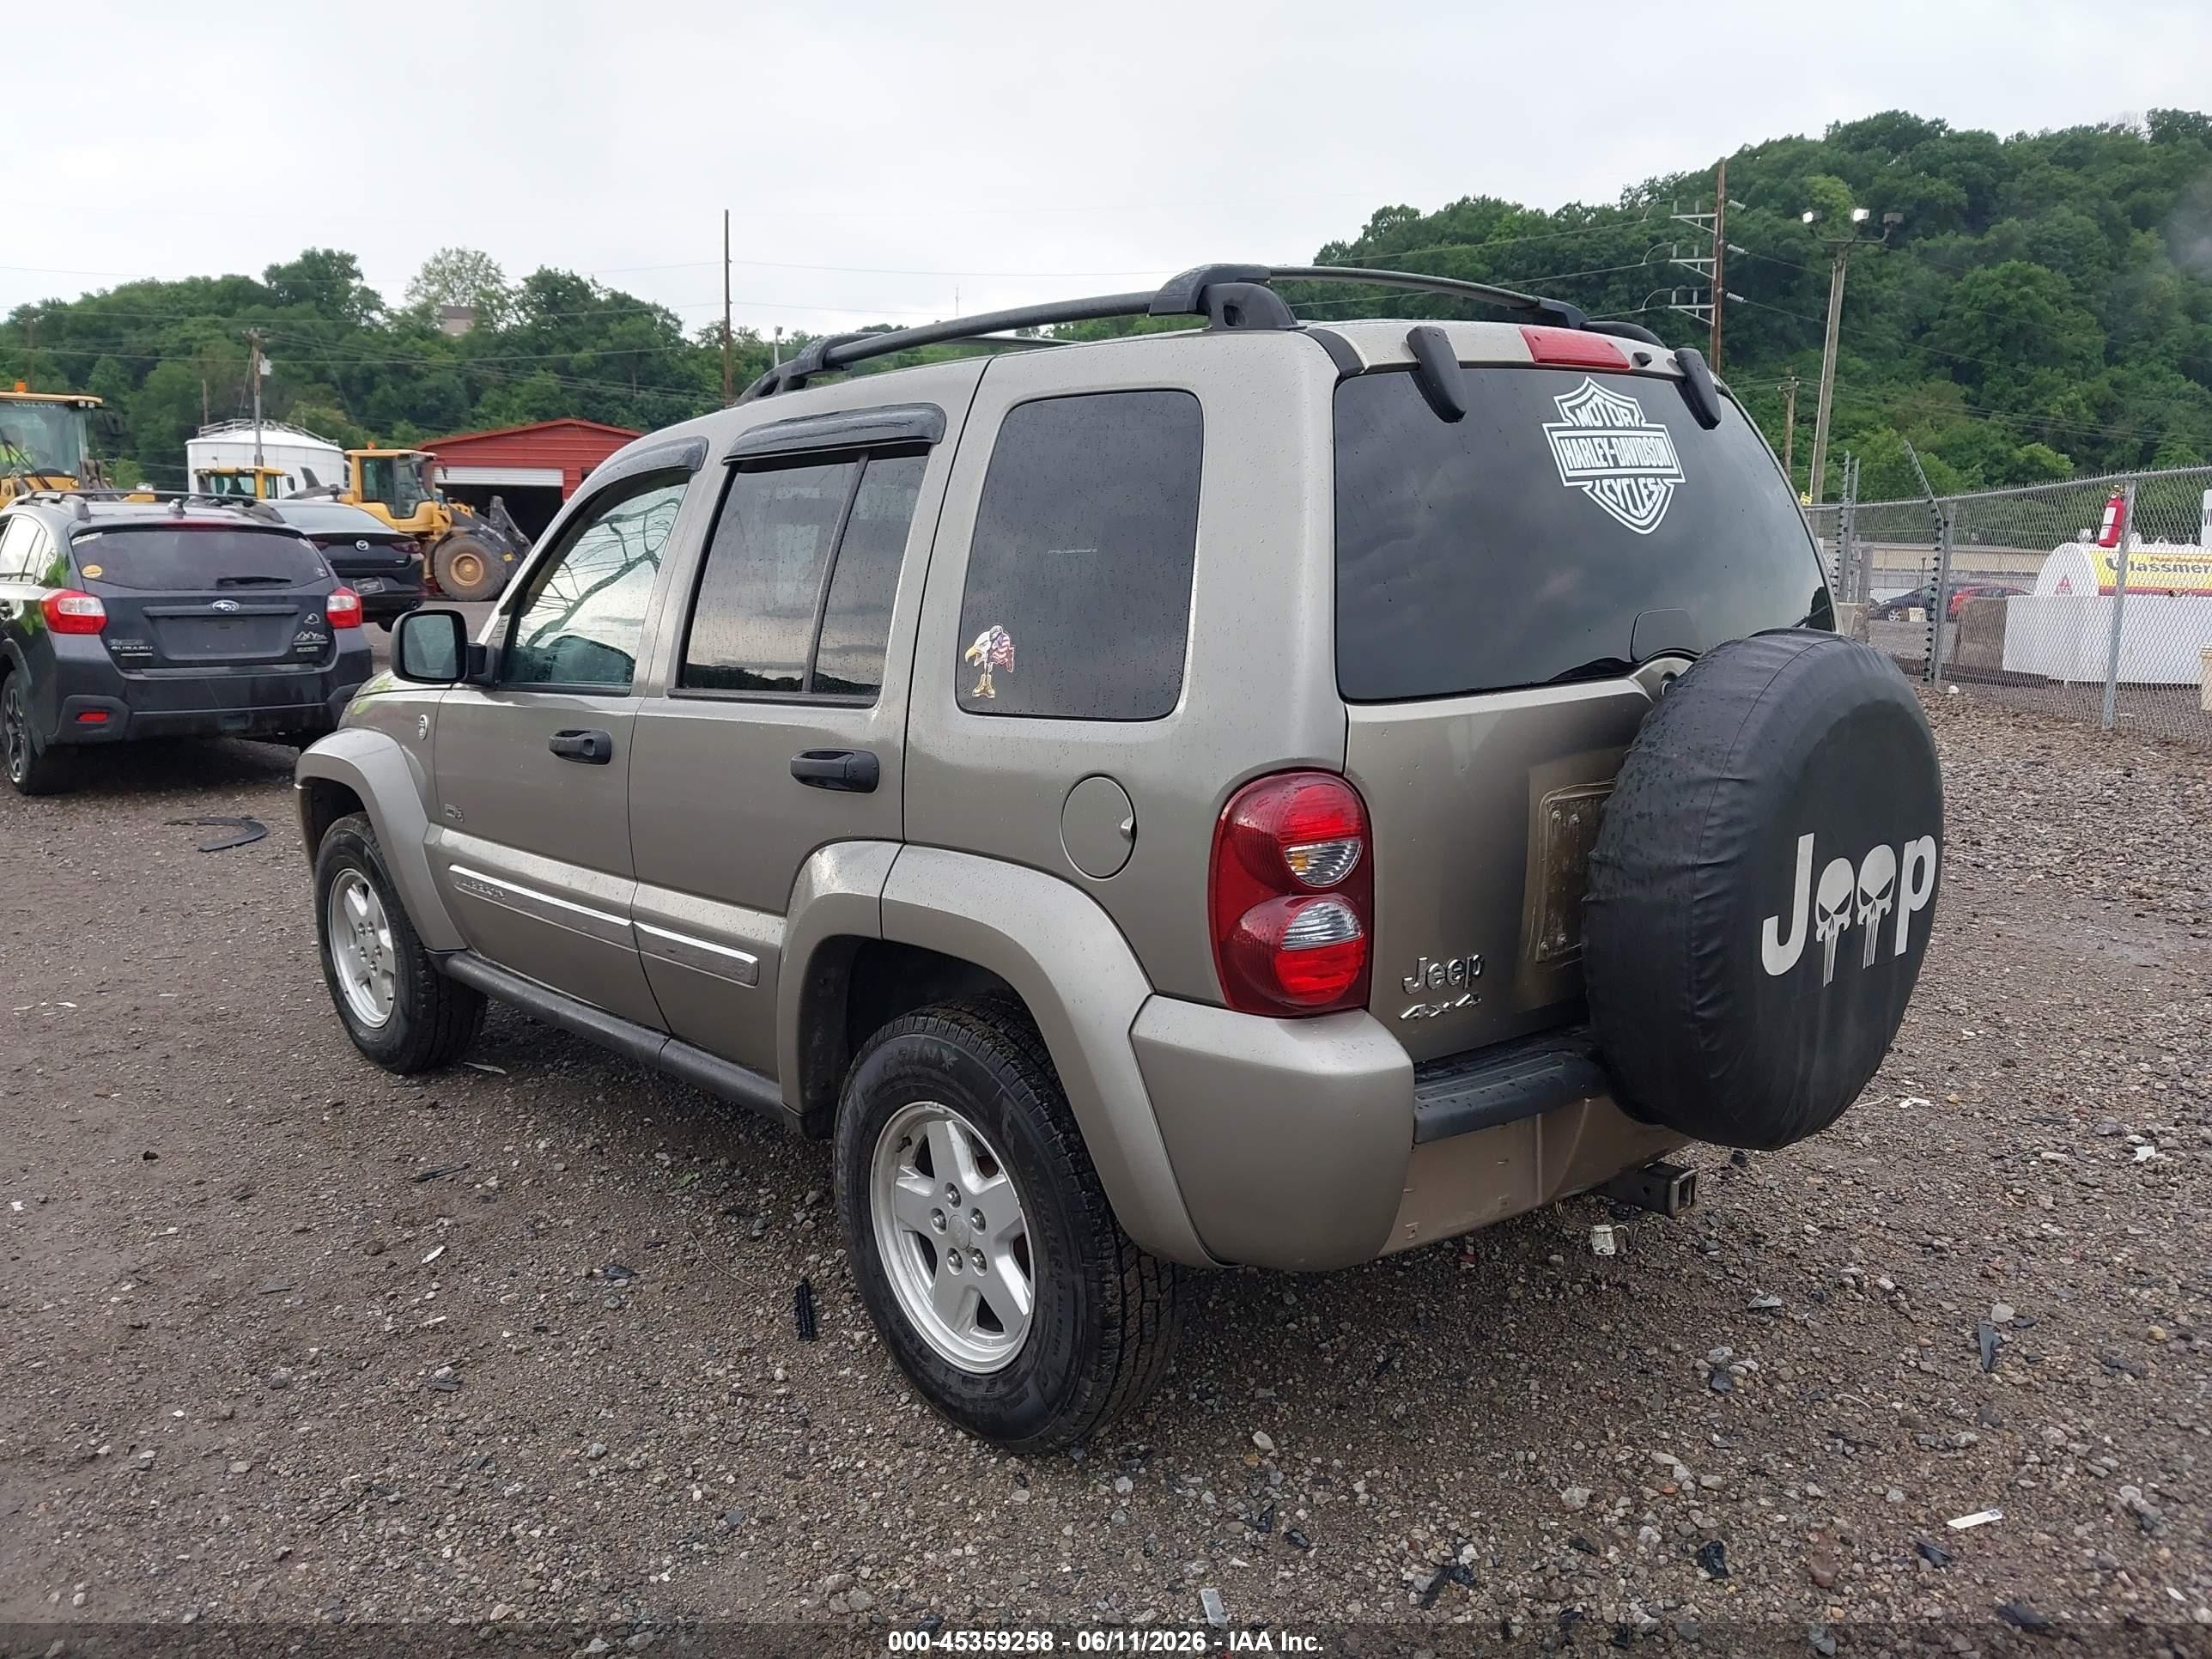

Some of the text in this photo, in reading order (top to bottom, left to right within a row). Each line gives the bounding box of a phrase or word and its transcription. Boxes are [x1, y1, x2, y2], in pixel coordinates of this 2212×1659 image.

[1575, 395, 1634, 428] MOTOR
[1559, 437, 1672, 468] HARLEY-DAVIDSON
[1601, 477, 1662, 518] CYCLES
[1401, 953, 1485, 994] Jeep
